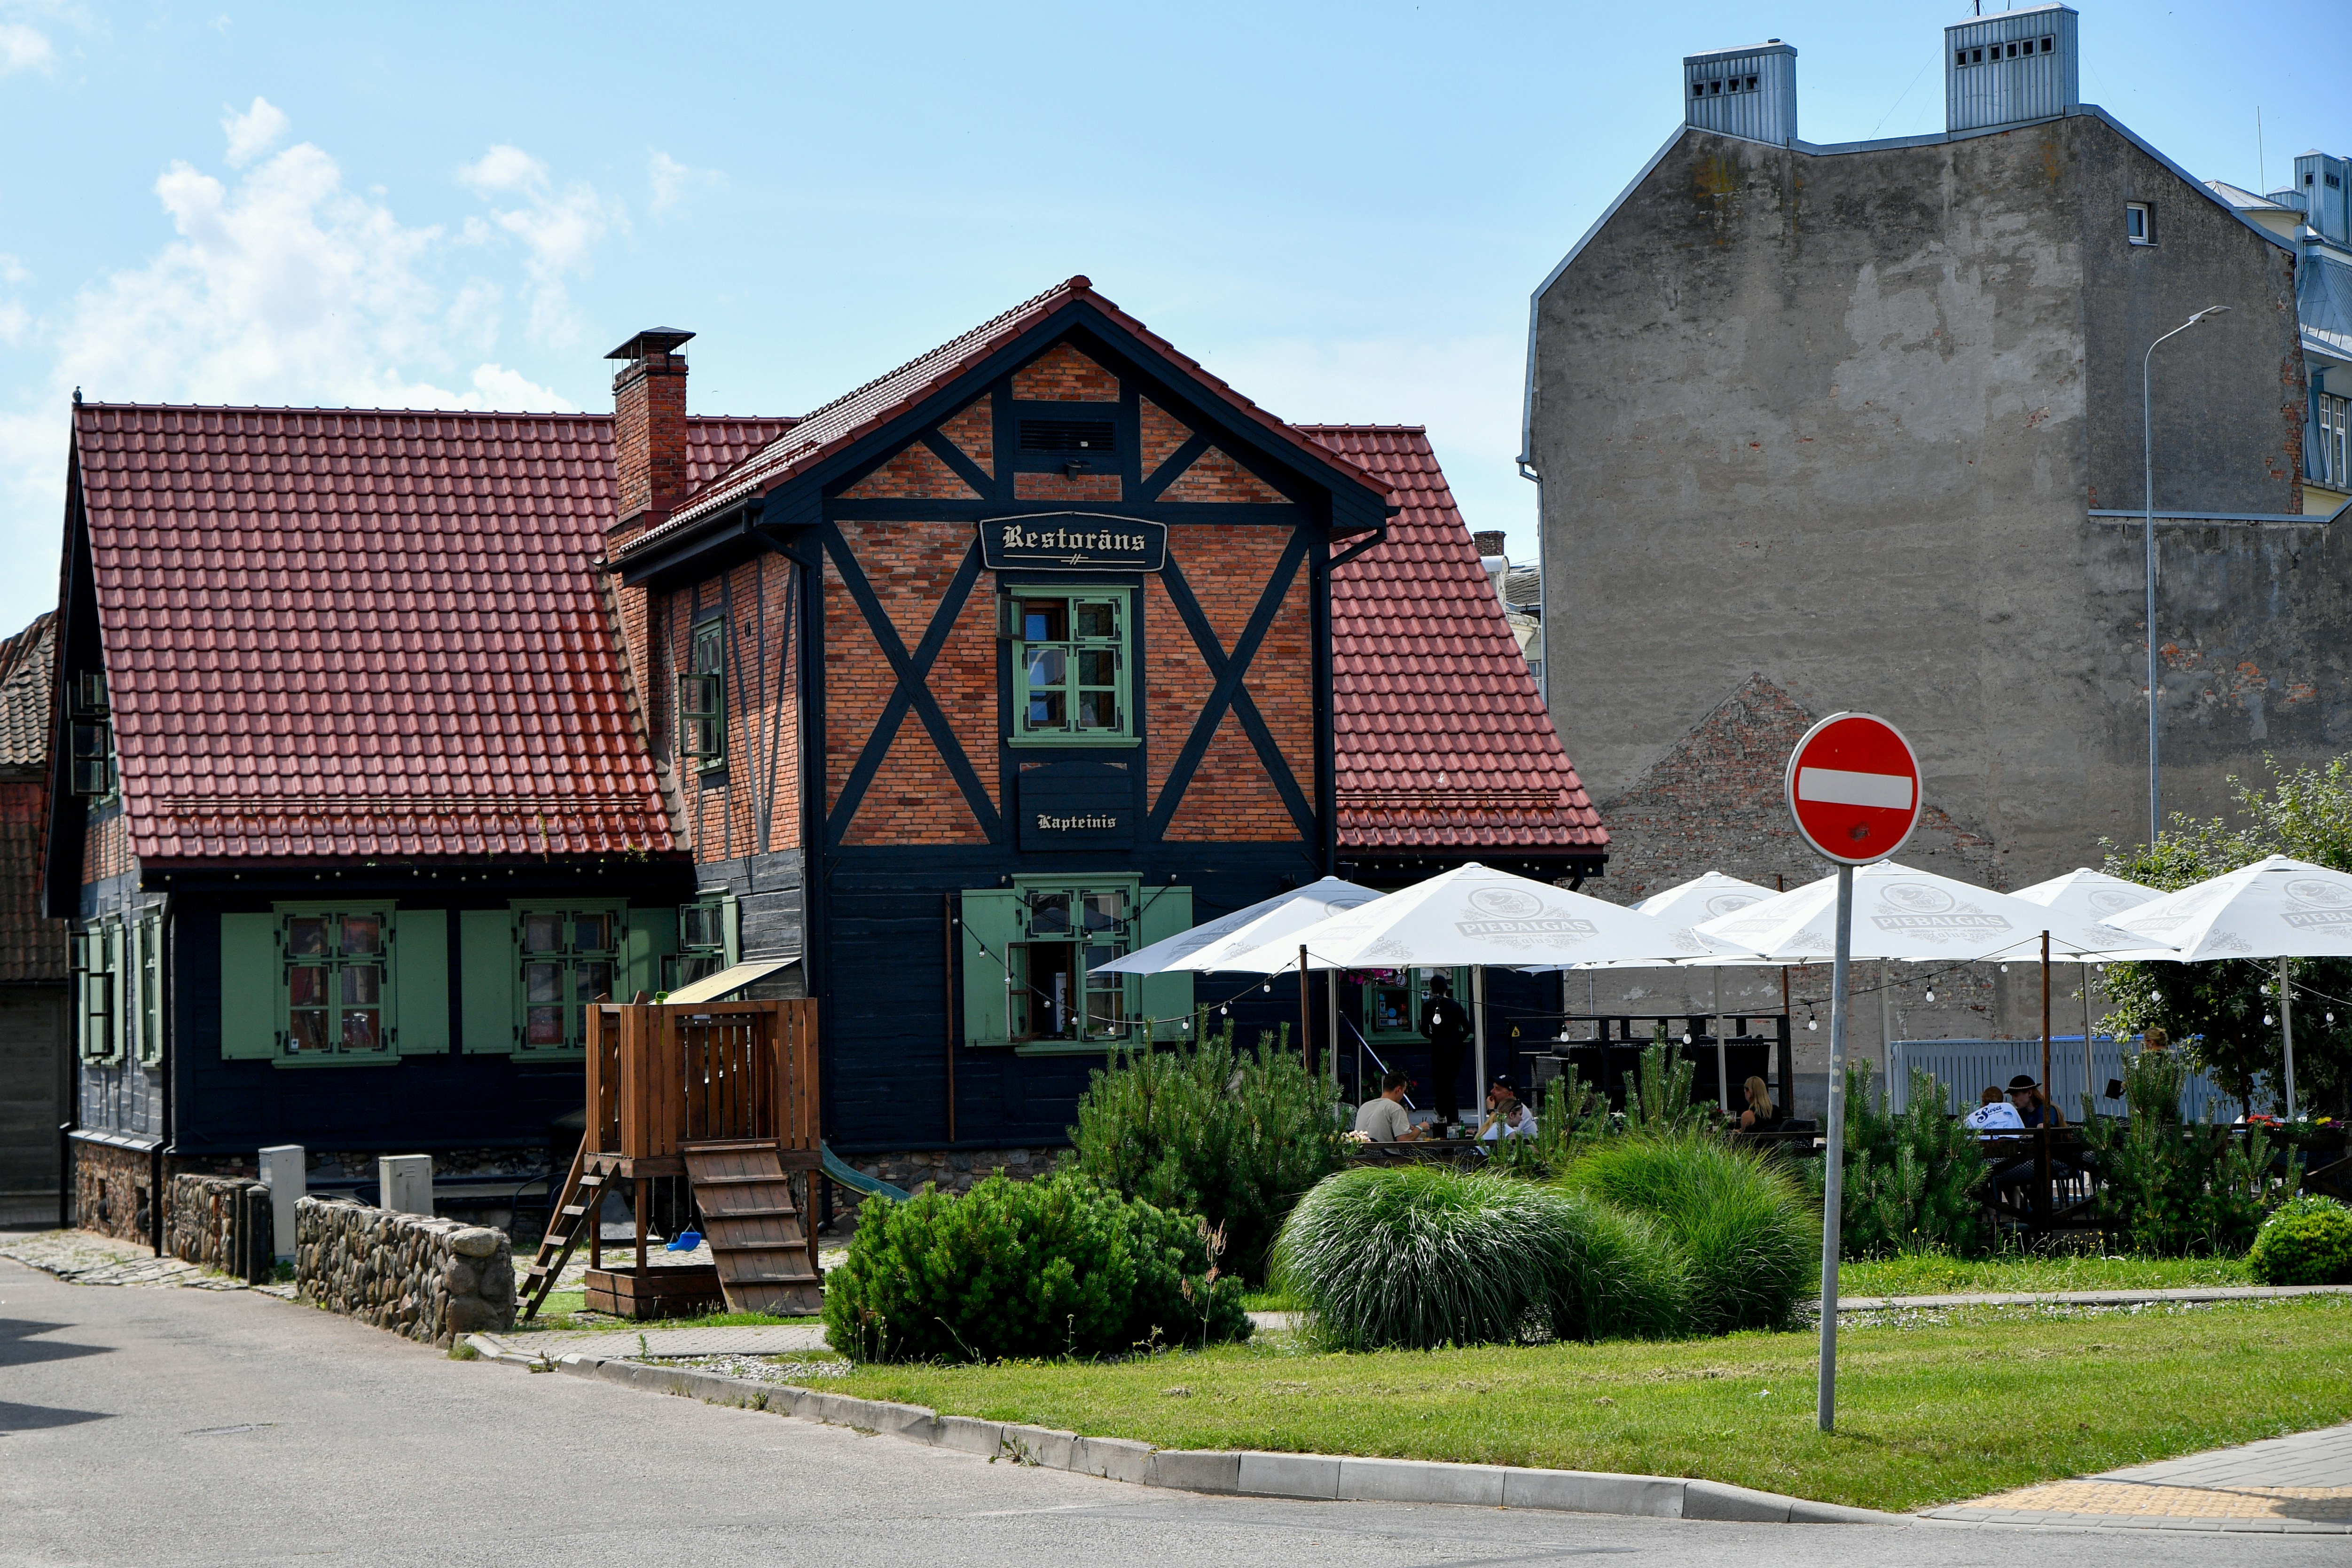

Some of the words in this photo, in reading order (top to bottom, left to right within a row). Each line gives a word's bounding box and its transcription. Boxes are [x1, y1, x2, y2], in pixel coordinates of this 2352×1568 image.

[1003, 524, 1145, 551] Restorāns
[1036, 814, 1117, 831] Kapteinis
[1461, 921, 1591, 934] PIEBALGAS
[1877, 916, 2005, 927] PIEBALGAS
[1975, 1105, 2002, 1123] Sweet
